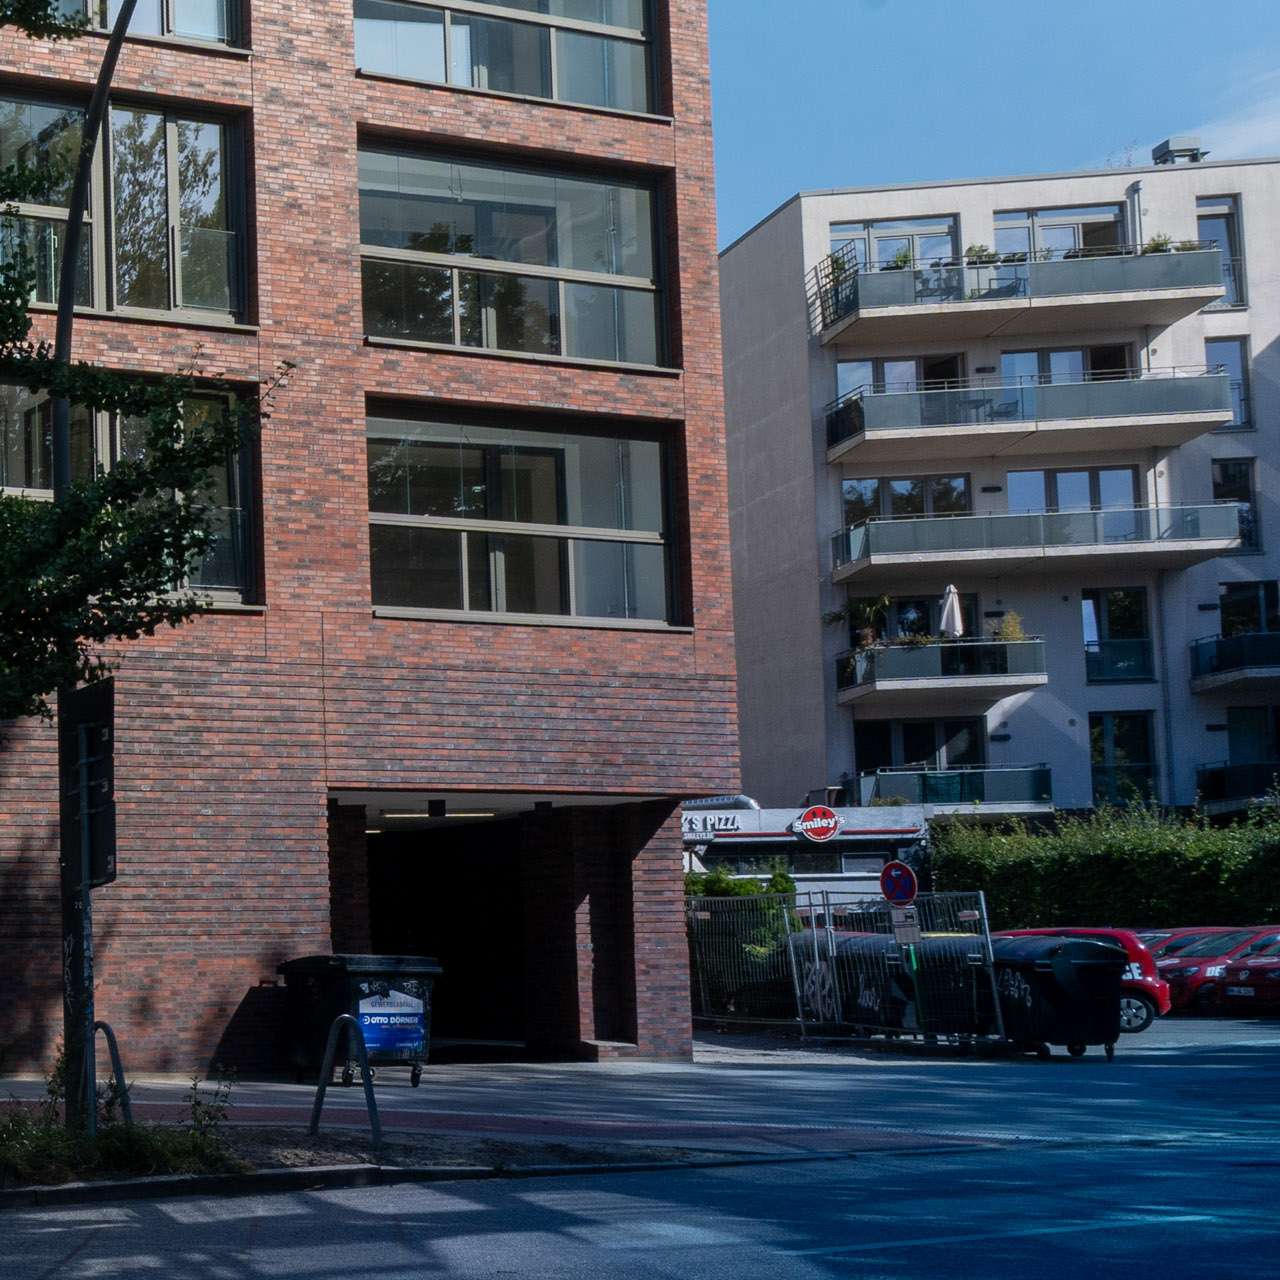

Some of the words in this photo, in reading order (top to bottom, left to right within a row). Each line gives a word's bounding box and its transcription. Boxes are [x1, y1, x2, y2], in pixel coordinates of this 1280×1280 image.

[706, 815, 742, 831] PIZZA
[793, 815, 846, 832] Smiley's
[370, 1016, 389, 1024] OTTO
